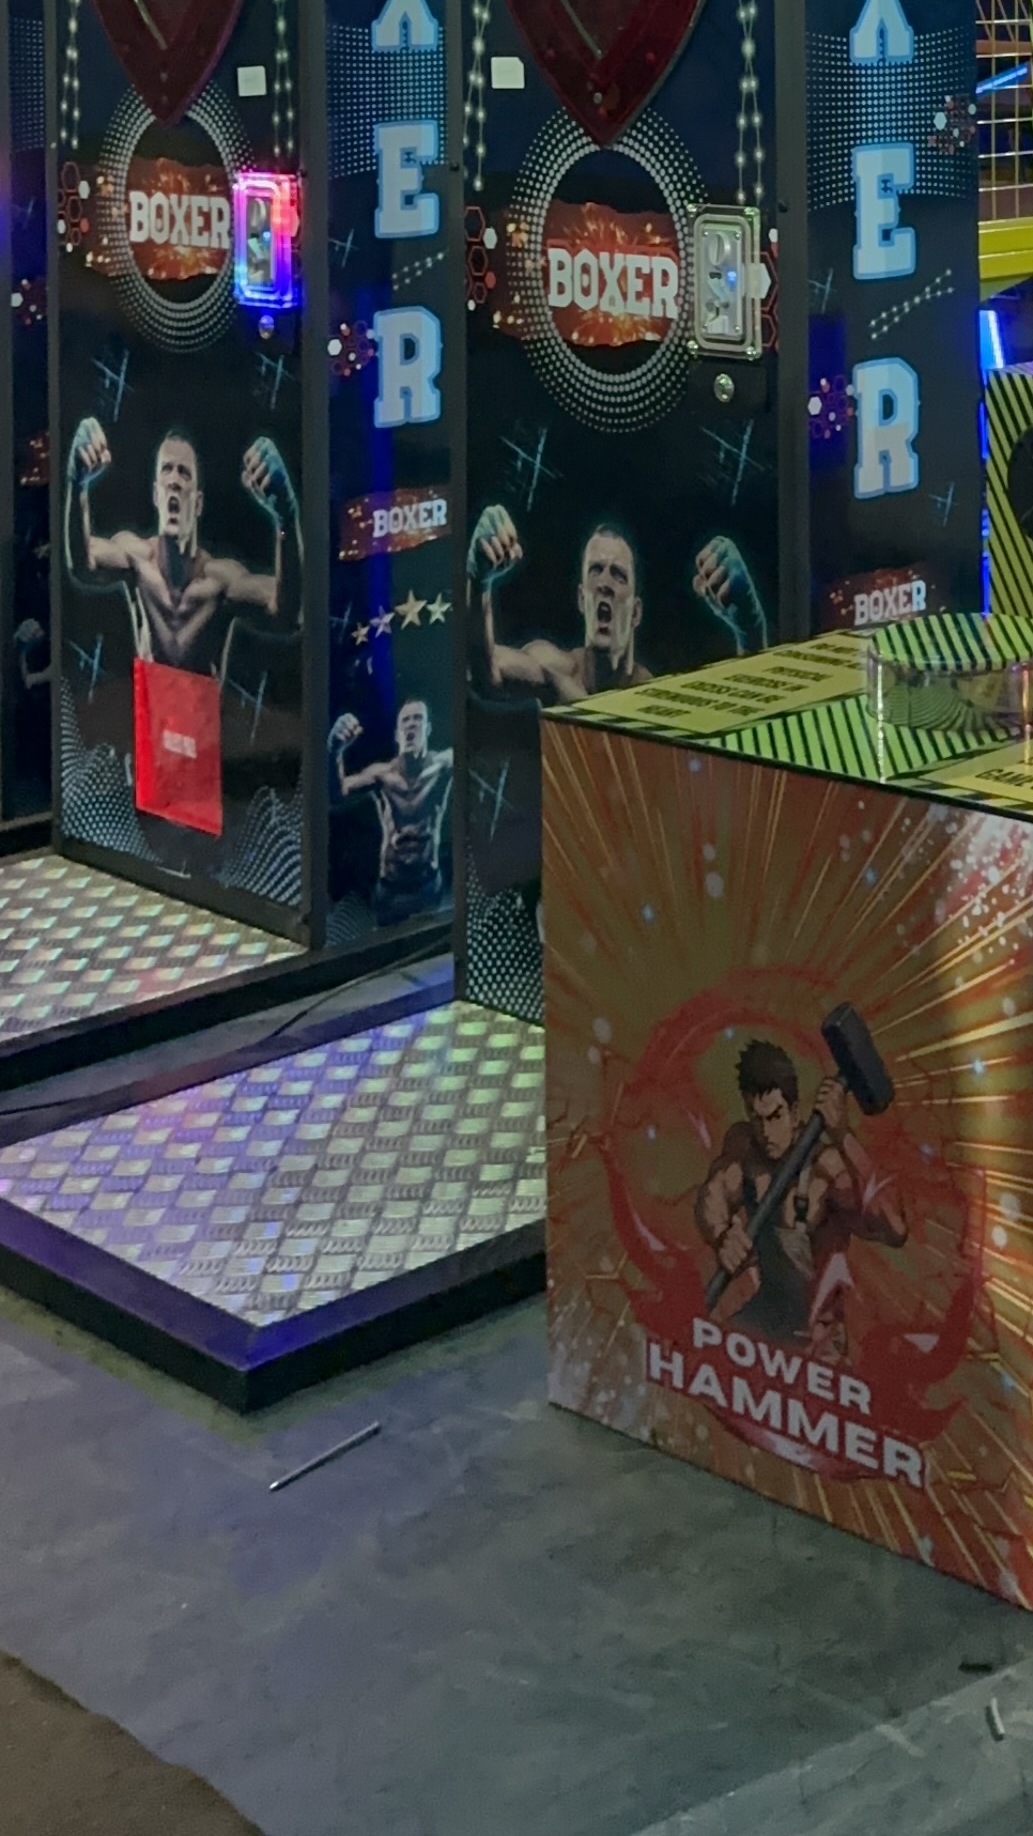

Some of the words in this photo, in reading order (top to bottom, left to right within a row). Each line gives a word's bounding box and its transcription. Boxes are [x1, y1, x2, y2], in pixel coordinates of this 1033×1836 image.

[129, 190, 231, 250] BOXER
[547, 247, 678, 319] BOXER
[372, 498, 448, 538] BOXER
[854, 580, 927, 626] BOXER
[692, 1316, 873, 1415] POWER
[650, 1342, 924, 1488] HAMMER
